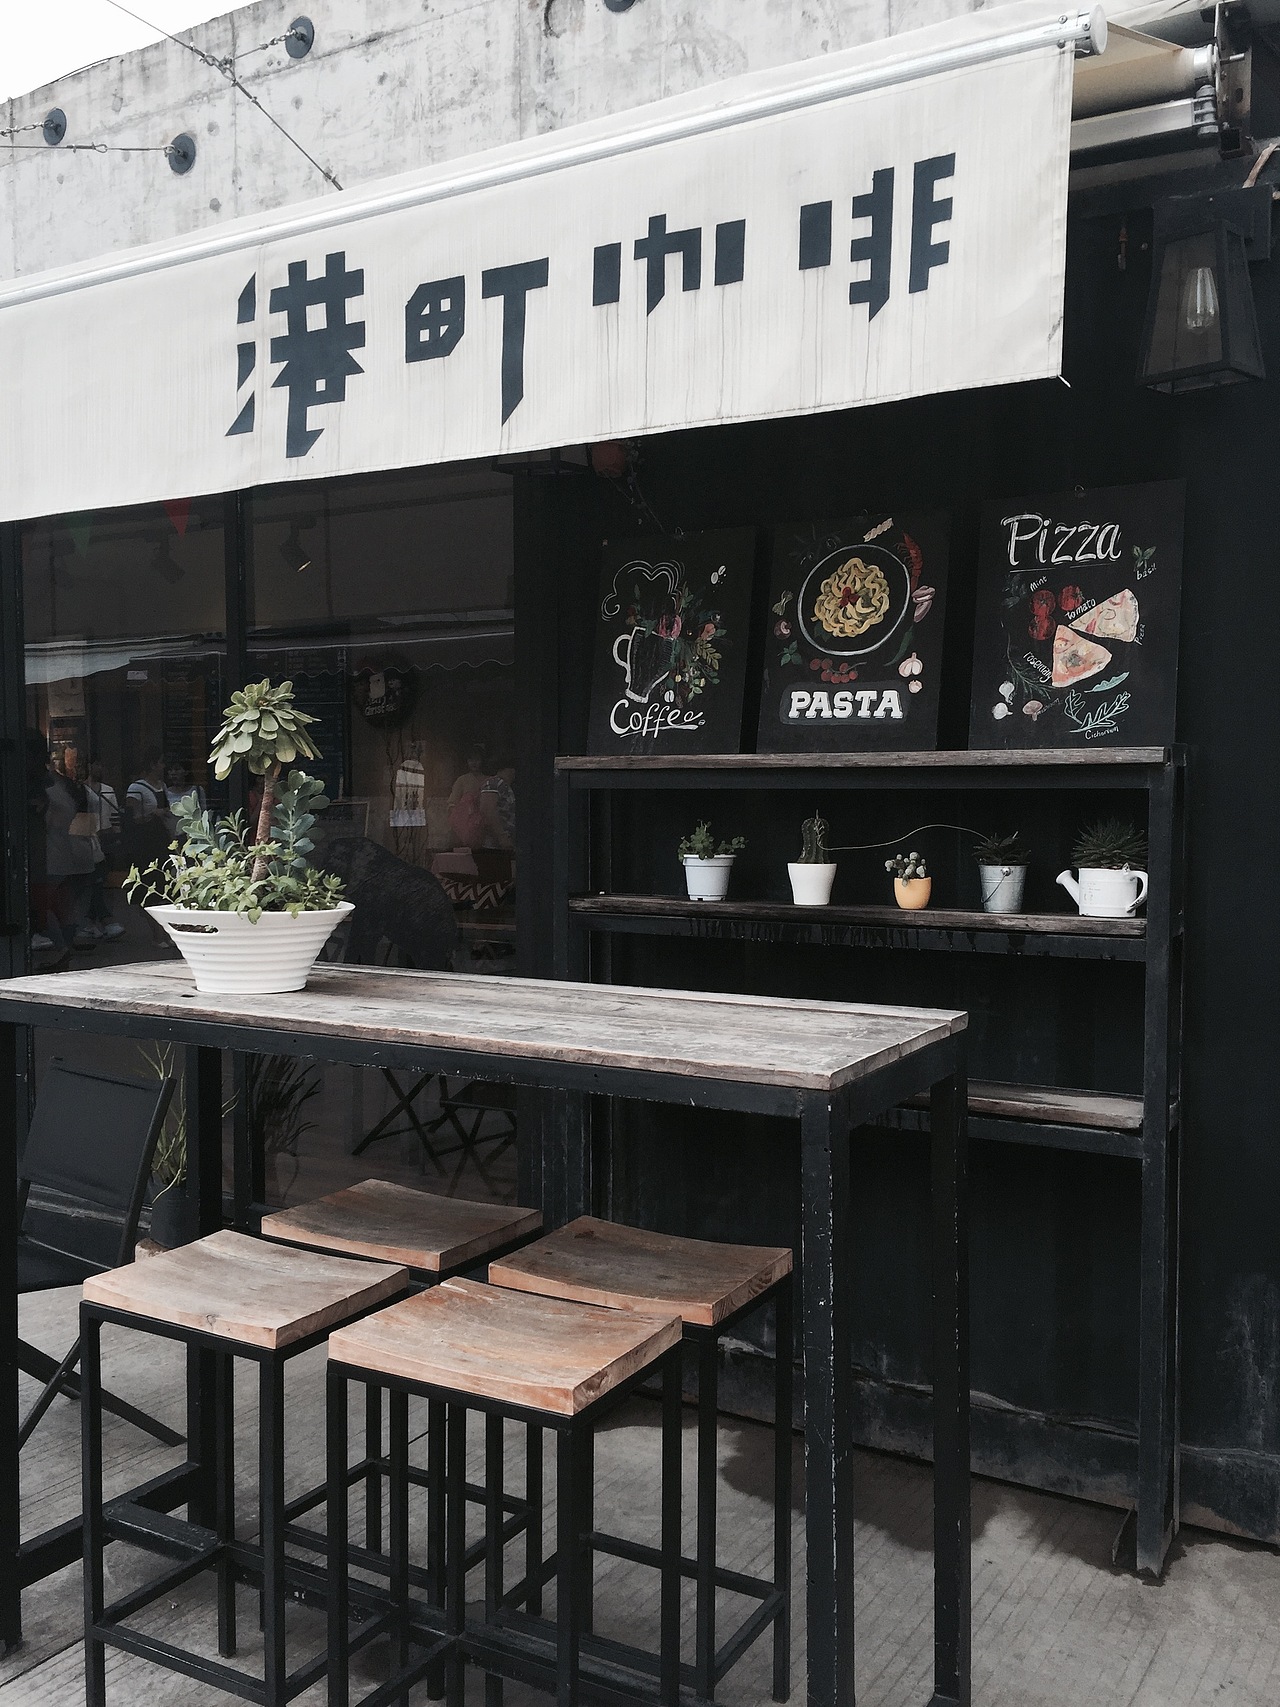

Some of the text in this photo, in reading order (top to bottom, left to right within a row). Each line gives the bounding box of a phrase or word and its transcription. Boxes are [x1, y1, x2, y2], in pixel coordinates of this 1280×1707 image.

[224, 152, 956, 459] 港町咖啡
[1001, 513, 1122, 565] Pizza
[1065, 599, 1096, 620] tomato
[610, 699, 705, 738] Coffee
[788, 690, 903, 719] PASTA
